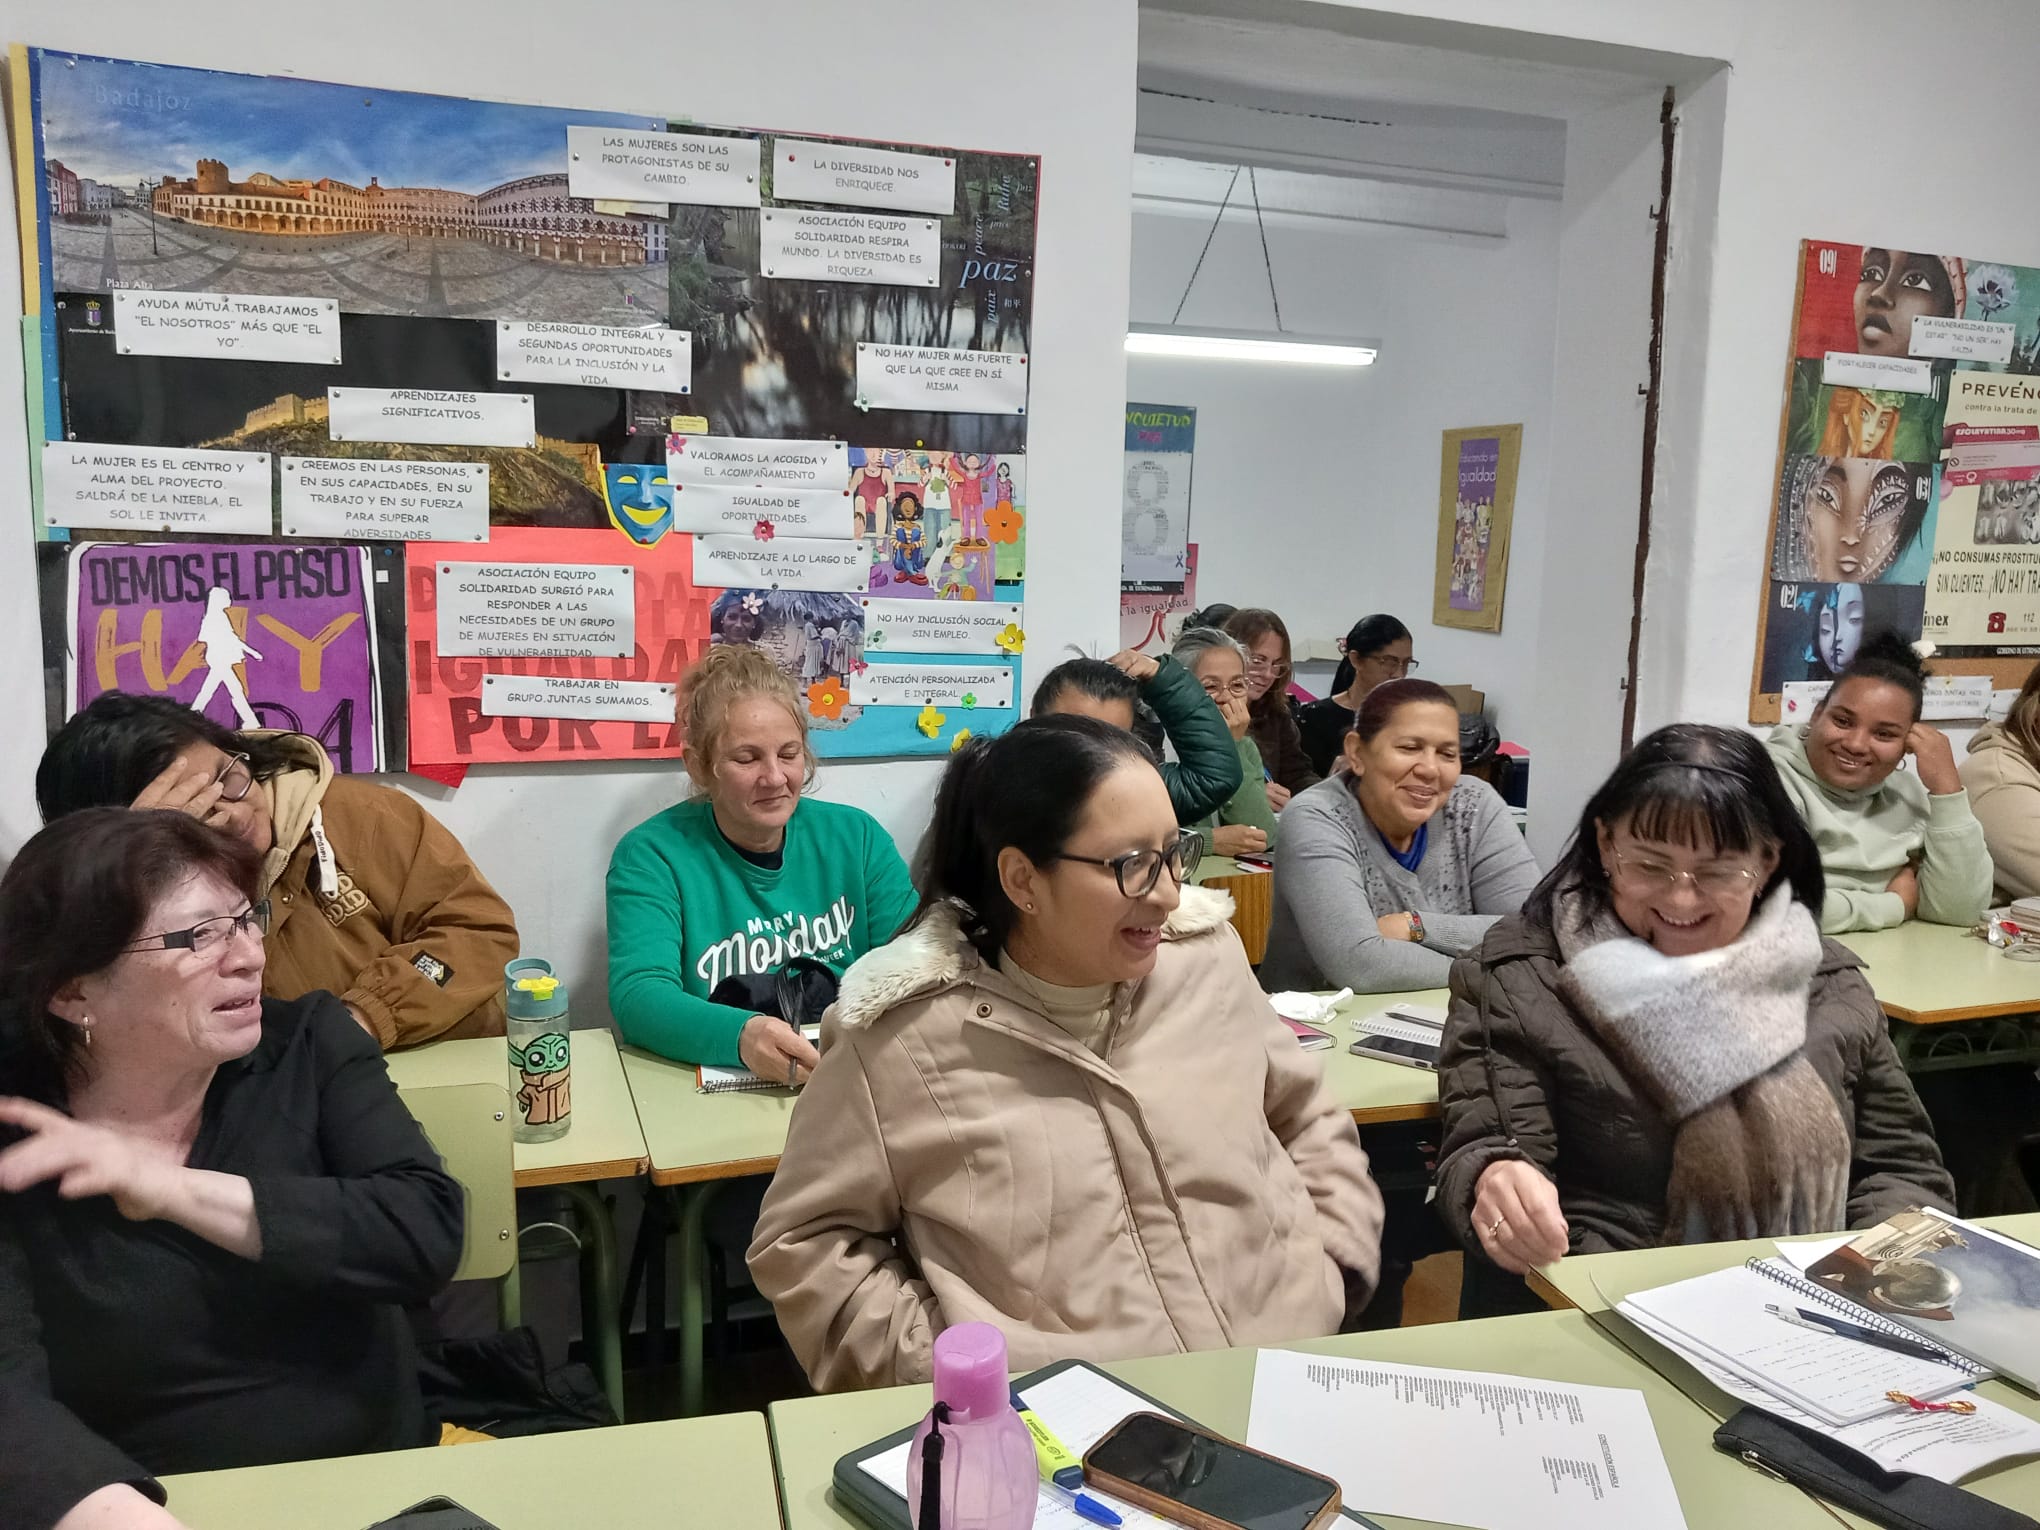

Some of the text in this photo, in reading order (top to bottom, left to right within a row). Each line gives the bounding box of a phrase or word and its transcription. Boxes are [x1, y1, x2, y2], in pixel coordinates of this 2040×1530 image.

[95, 83, 193, 113] Badajoz
[602, 137, 728, 155] LAS MUJERES SON LAS
[601, 154, 729, 172] PROTAGONISTAS DE SU
[813, 159, 919, 179] LA DIVERSIDAD NOS
[798, 216, 906, 231] ASOCIACIÓN EQUIPO
[794, 231, 909, 247] SOLIDARIDAD RESPIRA
[827, 248, 839, 258] LA
[843, 250, 905, 262] DIVERSIDAD
[909, 254, 922, 264] ES
[958, 258, 1018, 289] paz
[106, 278, 129, 289] Plaza
[137, 299, 180, 309] AYUDA
[240, 319, 268, 331] MÁS
[272, 322, 298, 333] QUE
[526, 323, 664, 341] DESARROLLO INTEGRAL Y
[518, 338, 672, 357] SEGUNDAS OPORTUNIDADES
[525, 354, 665, 373] PARA LA INCLUSIÓN Y LA
[389, 391, 477, 403] APRENDIZAJES
[71, 455, 244, 472] LA MUJER ES EL CENTRO Y
[690, 451, 827, 465] VALORAMOS LA ACOGIDA Y
[301, 460, 356, 471] CREEMOS
[359, 462, 376, 472] EN
[380, 463, 402, 473] LAS
[703, 466, 815, 479] EL ACOMPAÑAMIENTO
[90, 474, 126, 484] ALMA
[130, 476, 154, 486] DEL
[300, 476, 317, 486] EN
[320, 478, 345, 487] SUS
[436, 482, 453, 492] EN
[456, 484, 472, 493] SU
[75, 490, 126, 501] SALDRÁ
[130, 492, 147, 502] DE
[151, 493, 167, 503] LA
[228, 496, 243, 507] EL
[309, 493, 463, 508] TRABAJO Y EN SU FUERZA
[732, 496, 800, 508] IGUALDAD DE
[109, 509, 134, 519] SOL
[139, 510, 154, 520] LE
[345, 511, 429, 523] PARA SUPERAR
[1954, 551, 2000, 563] CONSUMAS
[89, 554, 208, 606] DEMOS
[212, 551, 250, 601] EL
[254, 547, 350, 600] PASO
[477, 568, 596, 580] ASOCIACIÓN EQUIPO
[1936, 574, 1949, 593] SIN
[2008, 570, 2026, 594] HAY
[458, 583, 614, 596] SOLIDARIDAD SURGIÓ PARA
[487, 600, 588, 611] RESPONDER A LAS
[459, 615, 615, 627] NECESIDADES DE UN GRUPO
[877, 614, 892, 622] NO
[895, 614, 914, 623] HAY
[917, 614, 970, 624] INCLUSIÓN
[459, 630, 615, 642] DE MUJERES EN SITUACIÓN
[911, 629, 931, 637] SIN
[478, 647, 493, 657] DE
[544, 679, 619, 689] TRABAJAR EN
[869, 674, 995, 684] ATENCIÓN PERSONALIZADA
[904, 689, 910, 698] E
